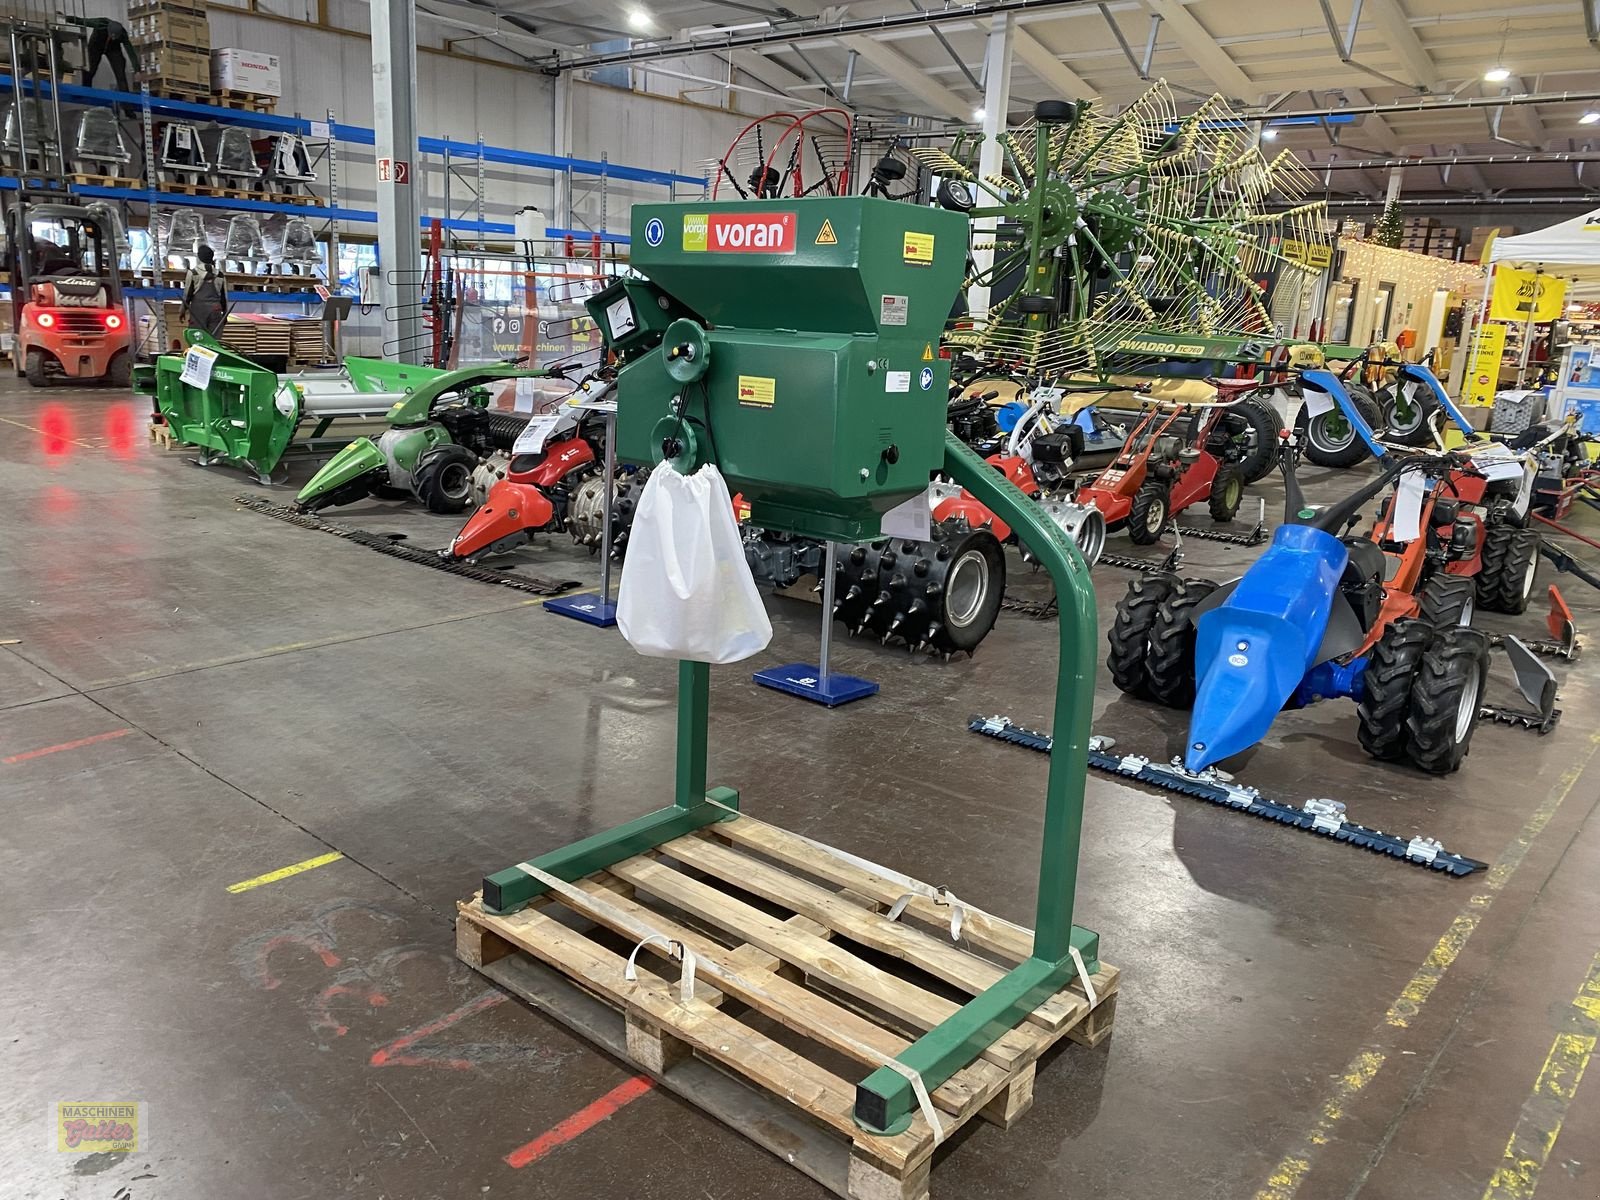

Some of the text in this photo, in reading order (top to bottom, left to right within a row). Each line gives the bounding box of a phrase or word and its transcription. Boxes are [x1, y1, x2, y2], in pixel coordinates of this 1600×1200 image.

[241, 61, 270, 71] HONDA
[715, 223, 784, 247] voran
[56, 278, 97, 287] Linde
[1117, 339, 1176, 353] SWADRO
